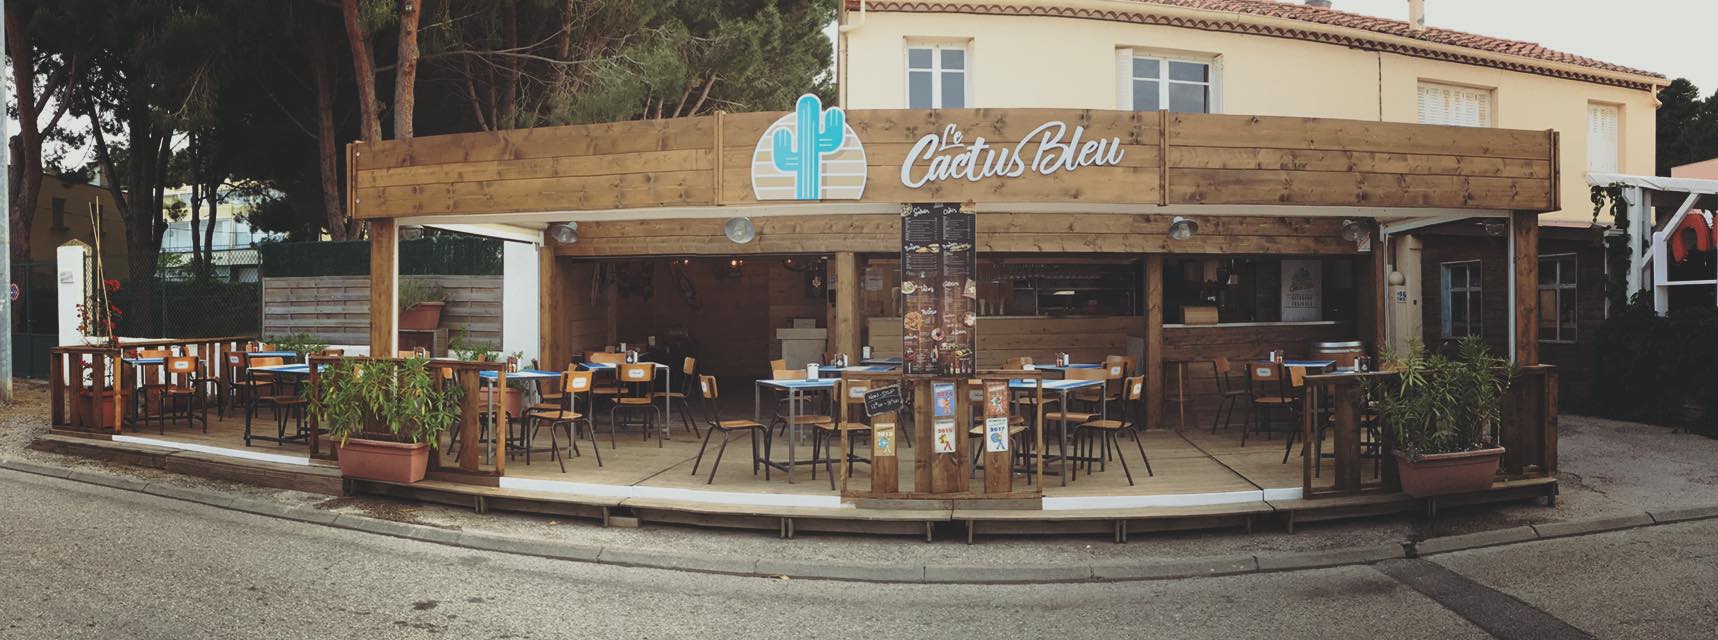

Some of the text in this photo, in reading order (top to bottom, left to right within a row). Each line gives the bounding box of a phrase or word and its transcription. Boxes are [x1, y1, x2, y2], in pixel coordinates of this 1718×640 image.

[900, 120, 1125, 189] Cactus Bleu
[939, 123, 965, 151] Le
